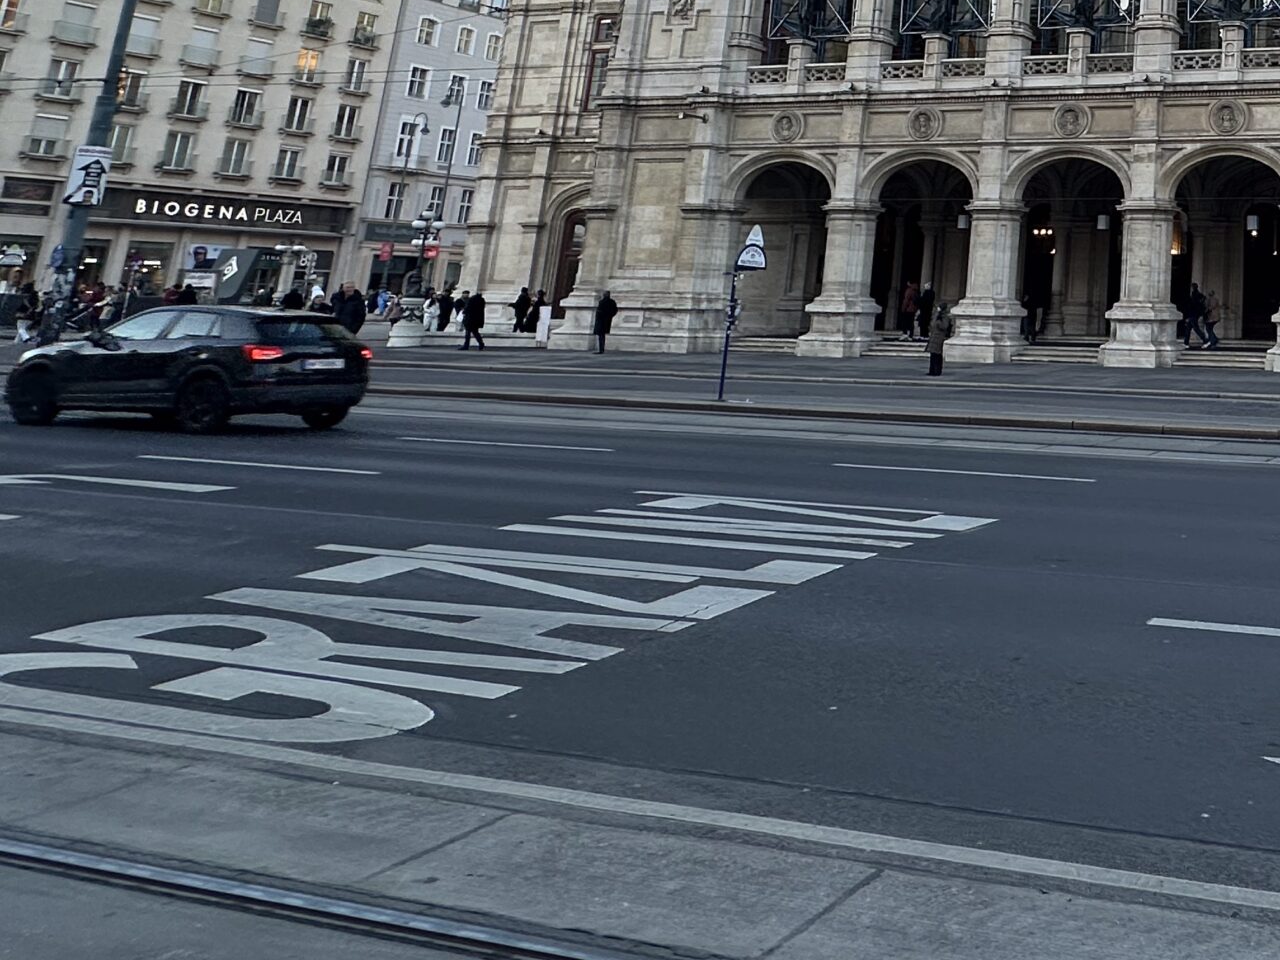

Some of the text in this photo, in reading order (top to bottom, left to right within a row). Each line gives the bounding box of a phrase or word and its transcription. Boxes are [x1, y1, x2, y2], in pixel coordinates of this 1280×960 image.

[135, 198, 303, 224] BIOGENA PLAZA
[0, 554, 776, 744] GRAZ
